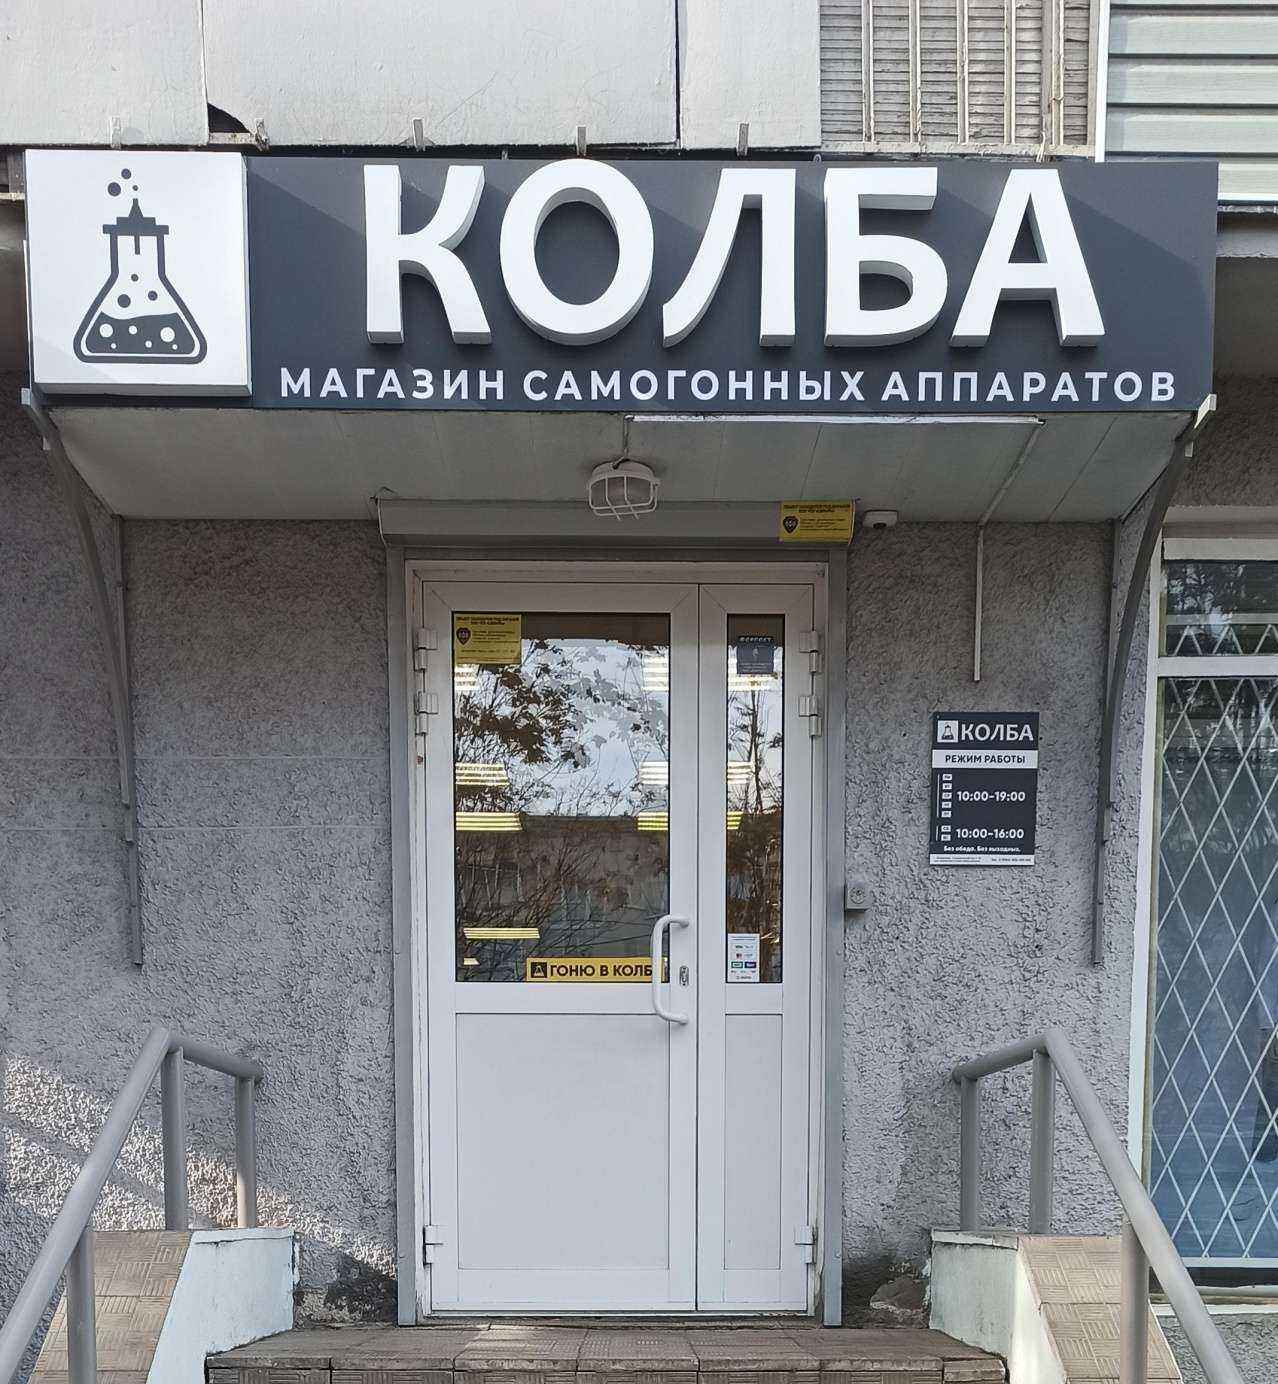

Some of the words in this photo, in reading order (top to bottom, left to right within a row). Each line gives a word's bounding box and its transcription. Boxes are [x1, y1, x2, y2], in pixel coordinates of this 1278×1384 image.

[362, 159, 1105, 347] КОЛБА
[280, 366, 505, 401] МАГАЗИН
[523, 368, 866, 402] САМОГОННЫХ
[880, 371, 1176, 402] АППАРАТОВ
[961, 723, 1034, 742] КОЛБА
[945, 754, 982, 764] РЕЖИМ
[984, 754, 1026, 764] РАБОТЫ
[550, 964, 595, 977] ГОНЮ
[600, 964, 610, 977] В
[613, 964, 653, 977] КОЛБ
